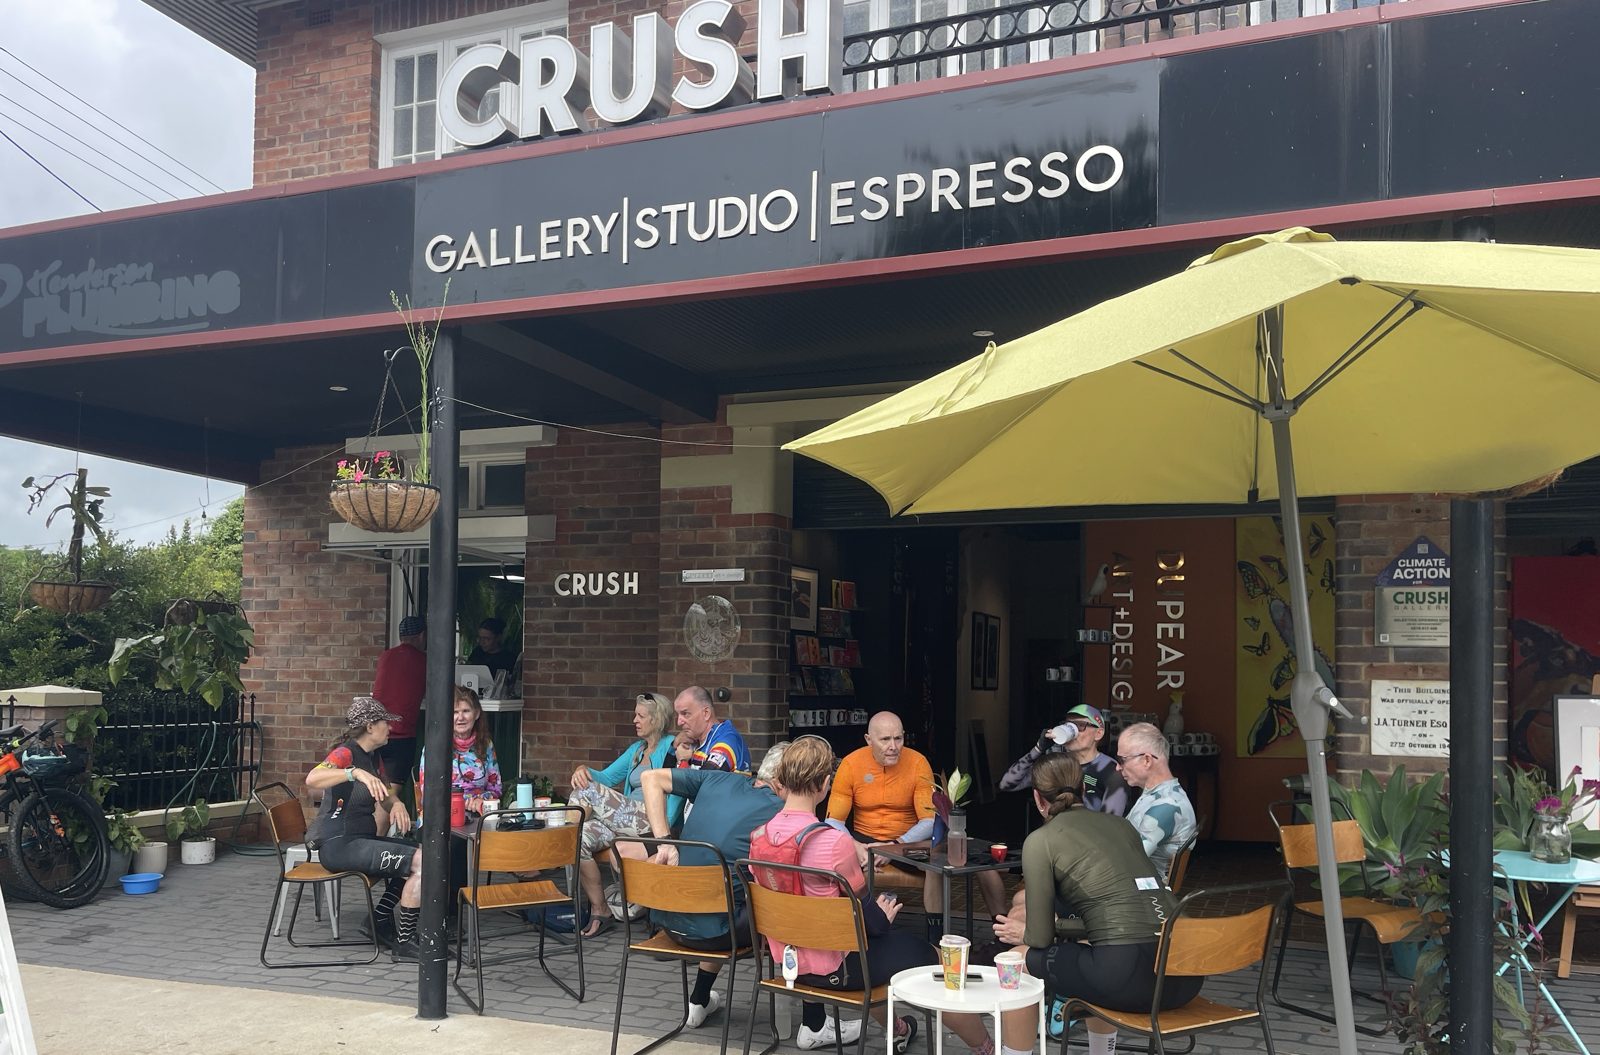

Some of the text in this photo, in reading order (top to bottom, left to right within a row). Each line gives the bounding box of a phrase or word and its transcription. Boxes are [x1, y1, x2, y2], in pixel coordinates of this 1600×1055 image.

[437, 0, 833, 146] CRUSH
[424, 145, 1125, 273] GALLERY STUDIO ESPRESSO
[1398, 559, 1446, 568] CLIMATE
[1392, 567, 1450, 580] ACTION
[554, 571, 639, 596] CRUSH
[1392, 591, 1449, 605] CRUSH
